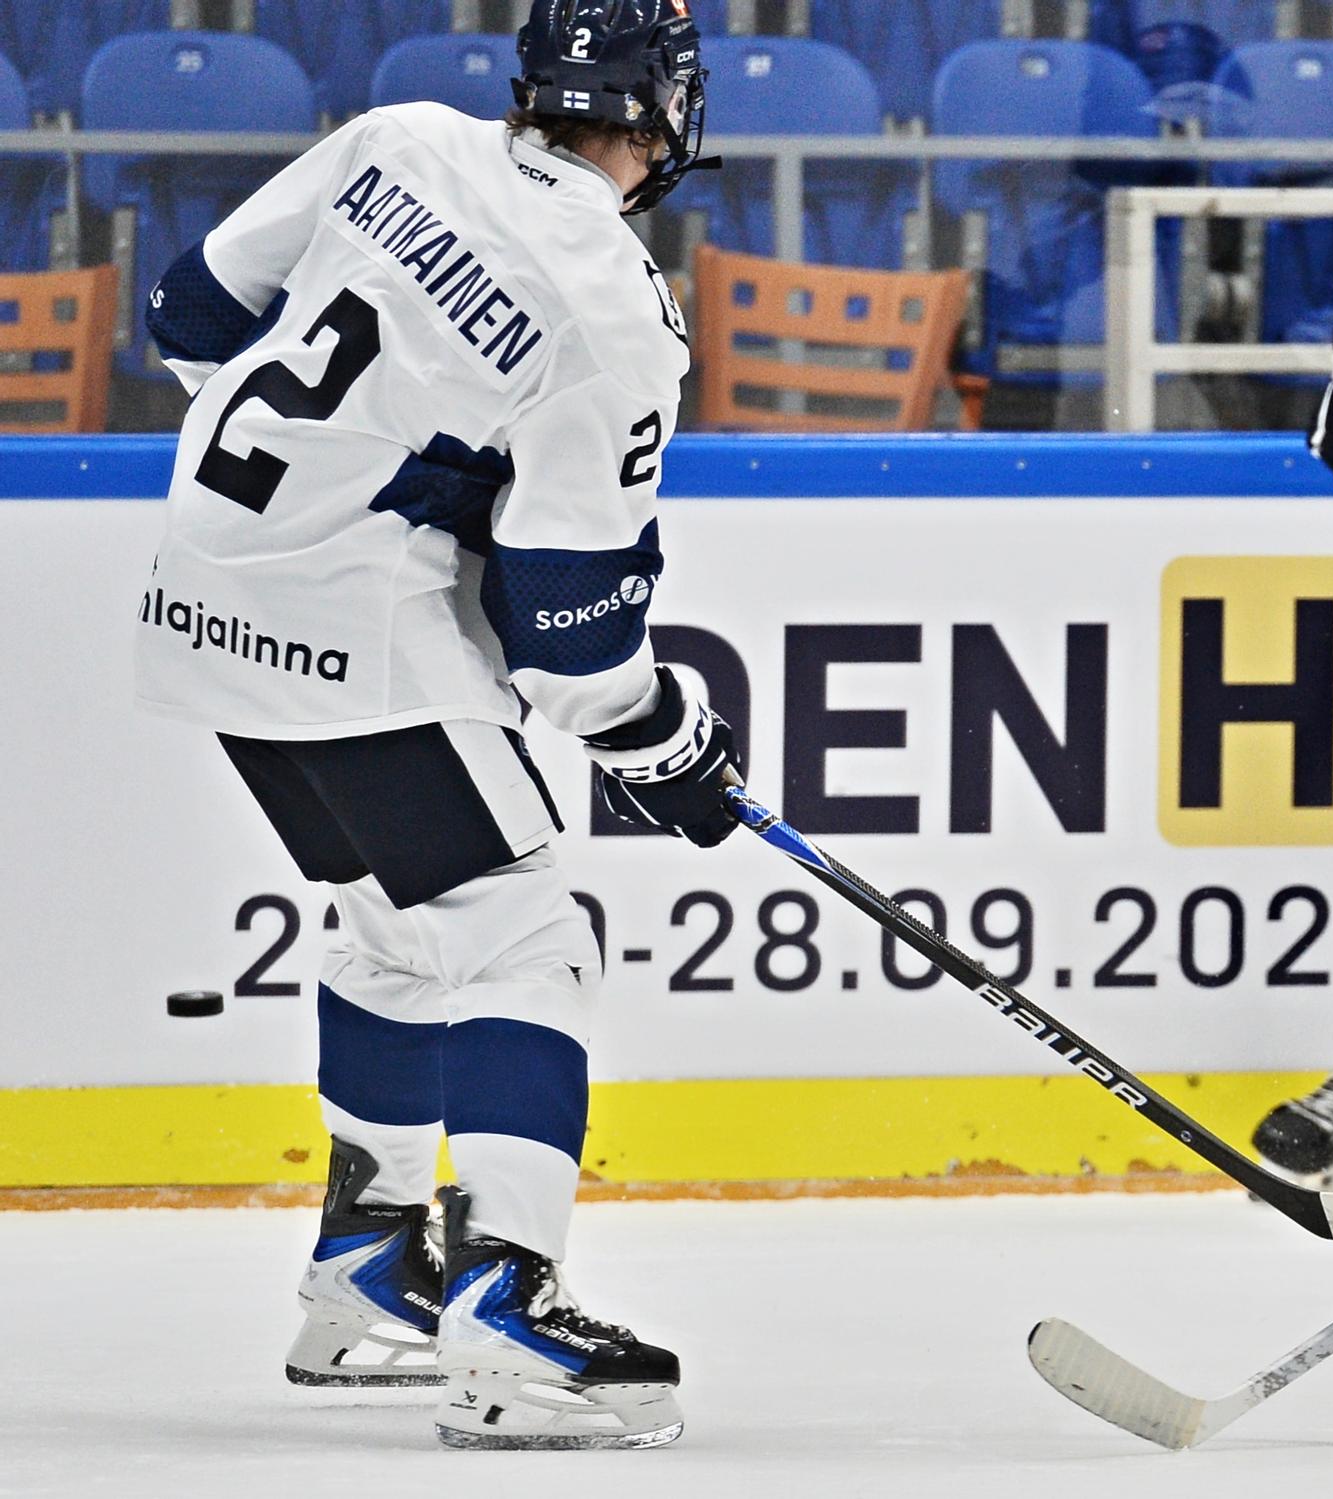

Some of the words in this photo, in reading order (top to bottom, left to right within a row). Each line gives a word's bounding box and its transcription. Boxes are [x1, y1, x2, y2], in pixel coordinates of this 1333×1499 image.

[571, 28, 591, 58] 2
[676, 50, 694, 63] CCM
[518, 163, 558, 187] CCM
[333, 163, 543, 377] AATIKAINEN
[195, 286, 381, 515] 2
[620, 409, 662, 488] 2
[535, 592, 621, 631] SOKOS
[588, 622, 1109, 836] DEN
[611, 699, 709, 782] CCM
[972, 983, 1149, 1111] BAUER
[403, 1290, 444, 1316] BAUE
[532, 1322, 598, 1354] BAUER
